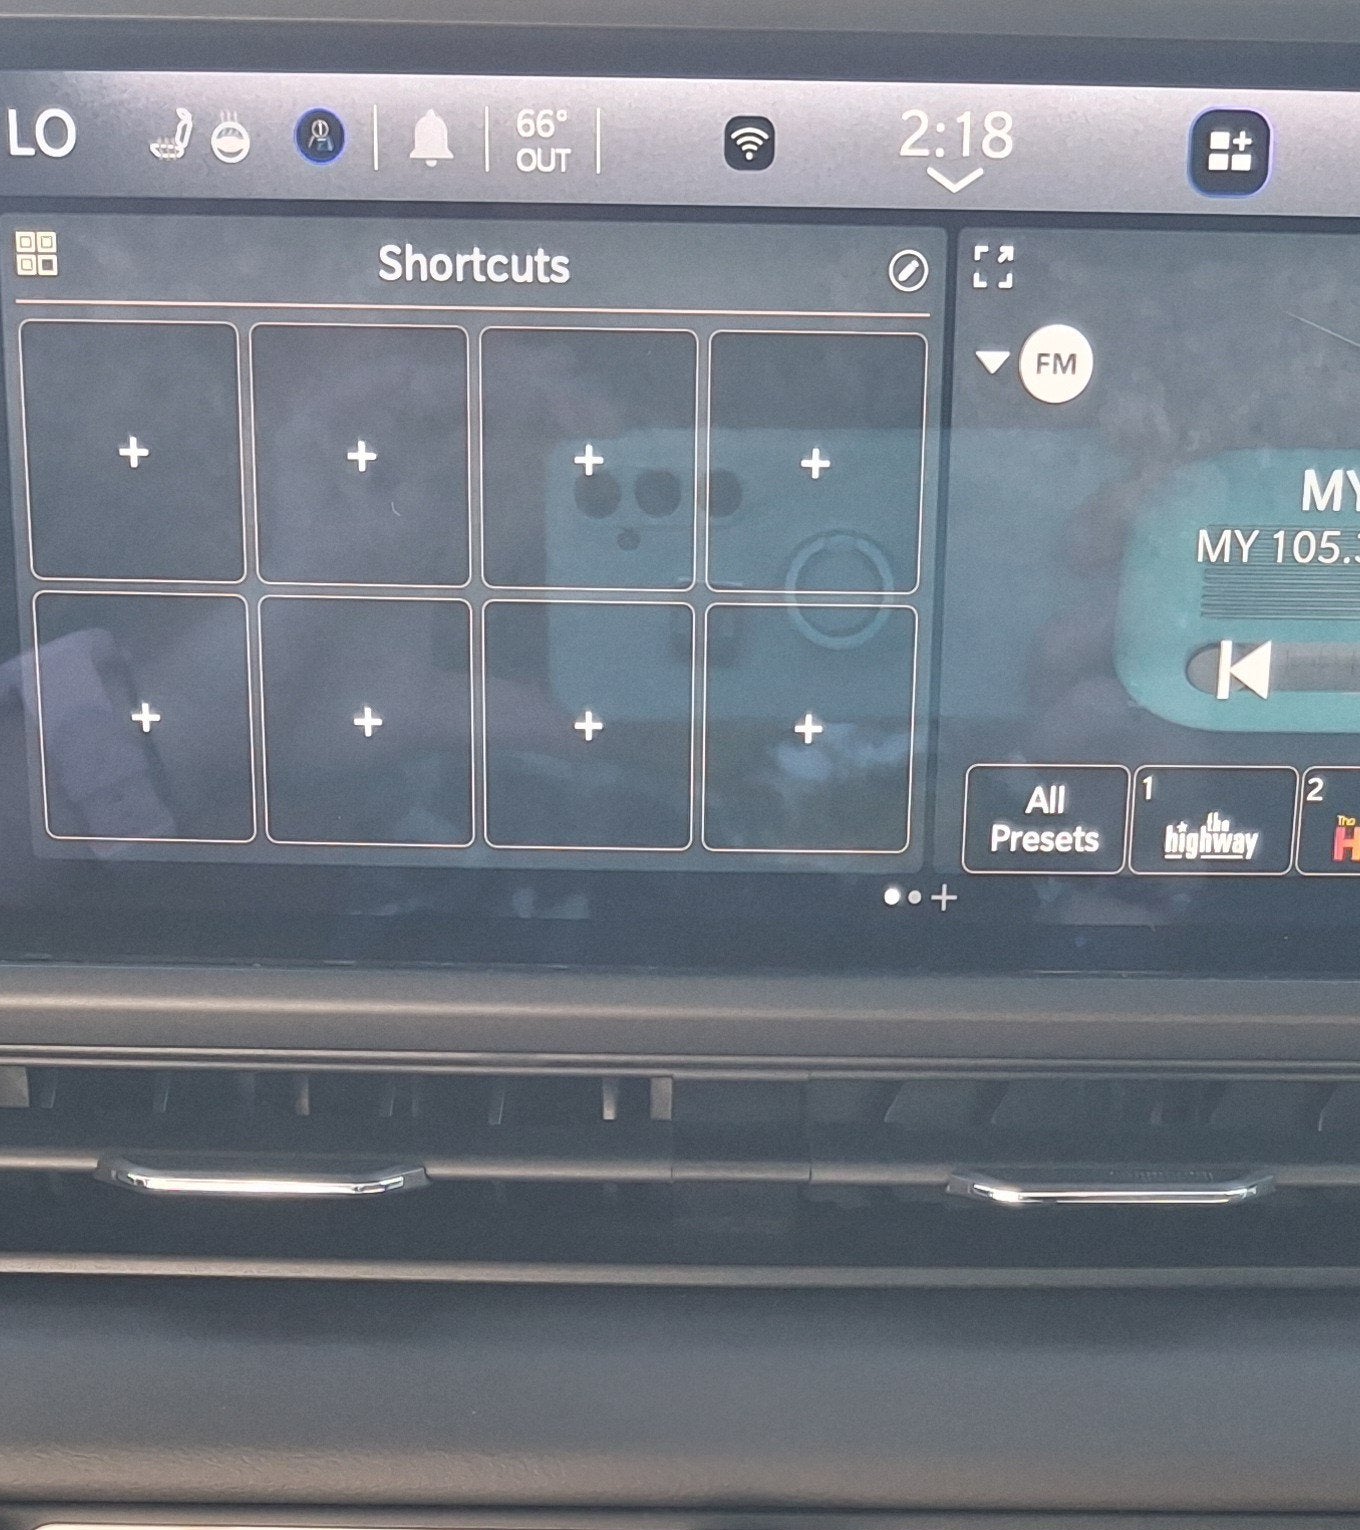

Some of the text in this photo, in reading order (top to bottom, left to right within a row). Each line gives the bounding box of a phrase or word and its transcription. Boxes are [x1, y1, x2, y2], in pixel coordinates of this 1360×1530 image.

[7, 107, 78, 158] LO
[516, 109, 568, 139] 66°
[898, 108, 1015, 160] 2:18
[516, 148, 572, 174] OUT
[378, 243, 571, 284] Shortcuts
[1035, 353, 1077, 376] FM
[1197, 529, 1260, 564] MY
[1024, 785, 1066, 814] All
[1142, 776, 1153, 800] 1
[1306, 777, 1324, 801] 2
[1207, 811, 1229, 832] the
[991, 823, 1100, 853] Presets
[1164, 825, 1259, 860] highway
